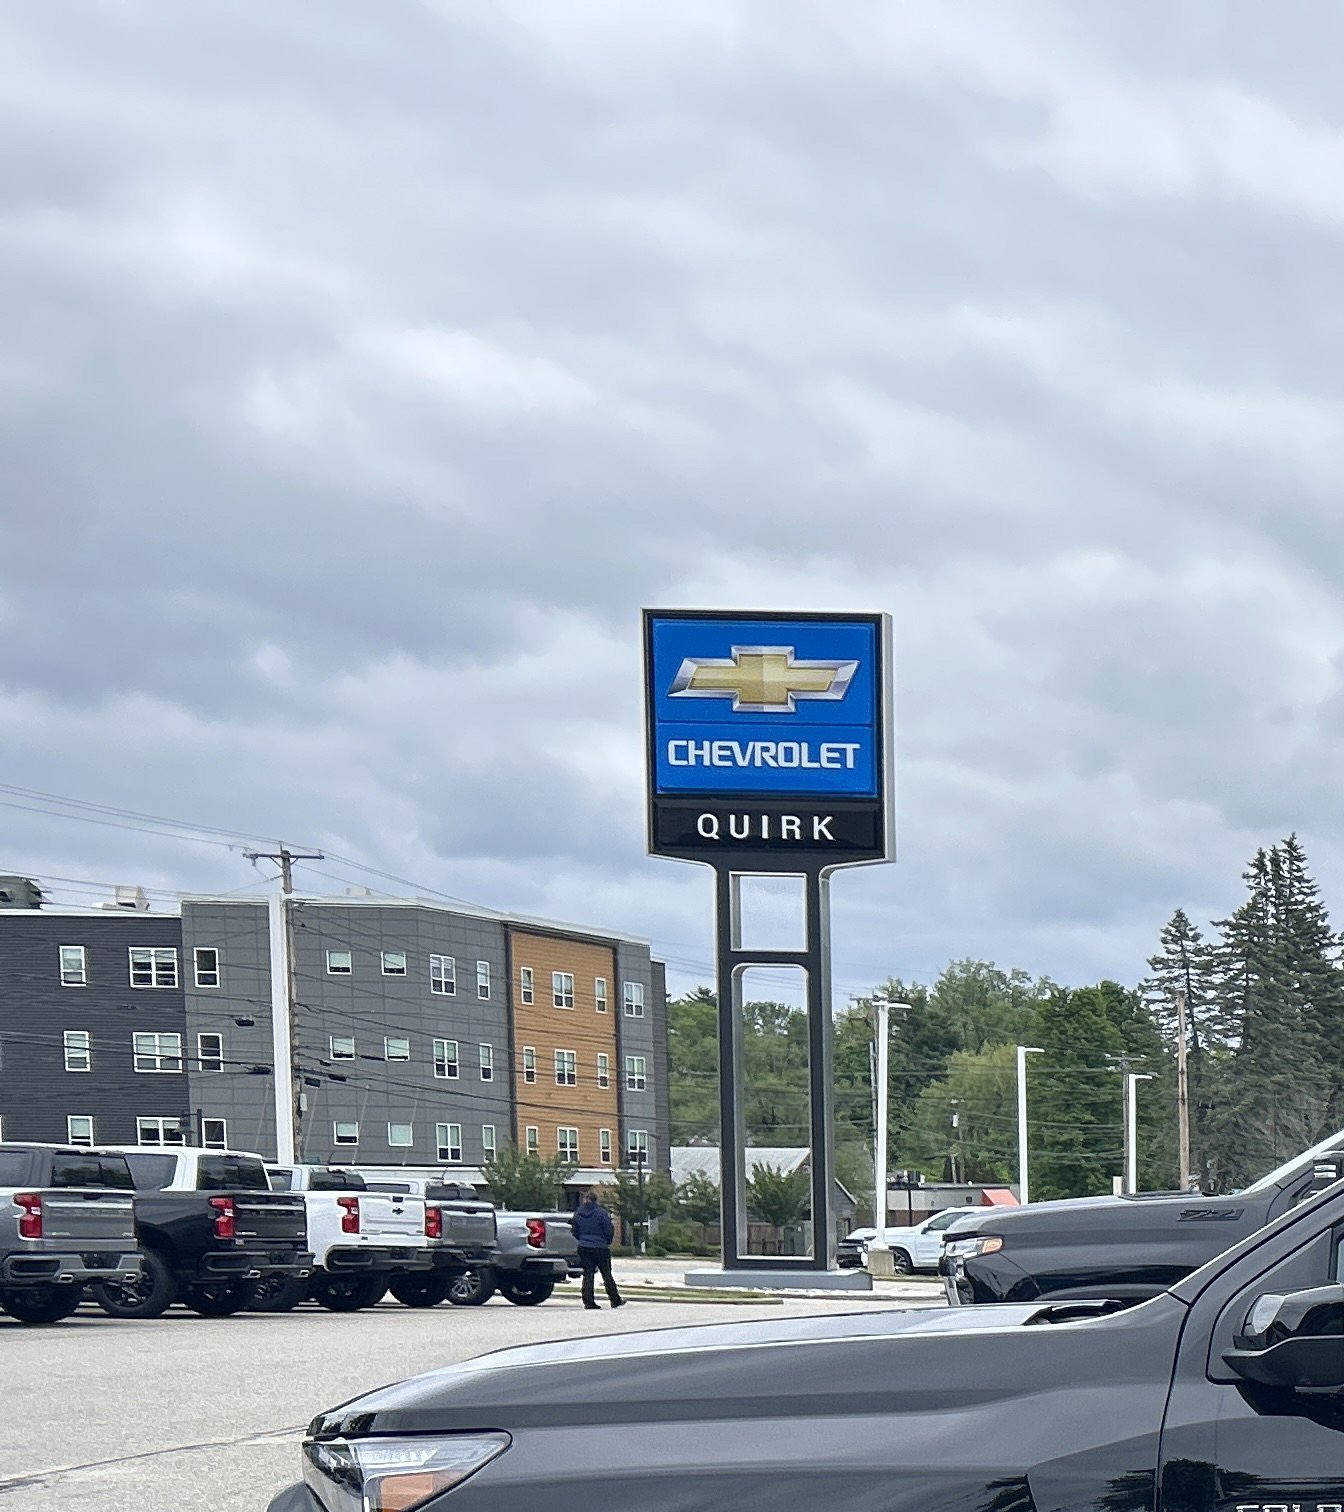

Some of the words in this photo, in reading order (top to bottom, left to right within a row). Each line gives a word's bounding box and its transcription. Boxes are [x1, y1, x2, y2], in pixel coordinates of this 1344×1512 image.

[667, 739, 862, 769] CHEVROLET
[696, 812, 836, 842] QUIRK
[1176, 1208, 1245, 1222] Z71
